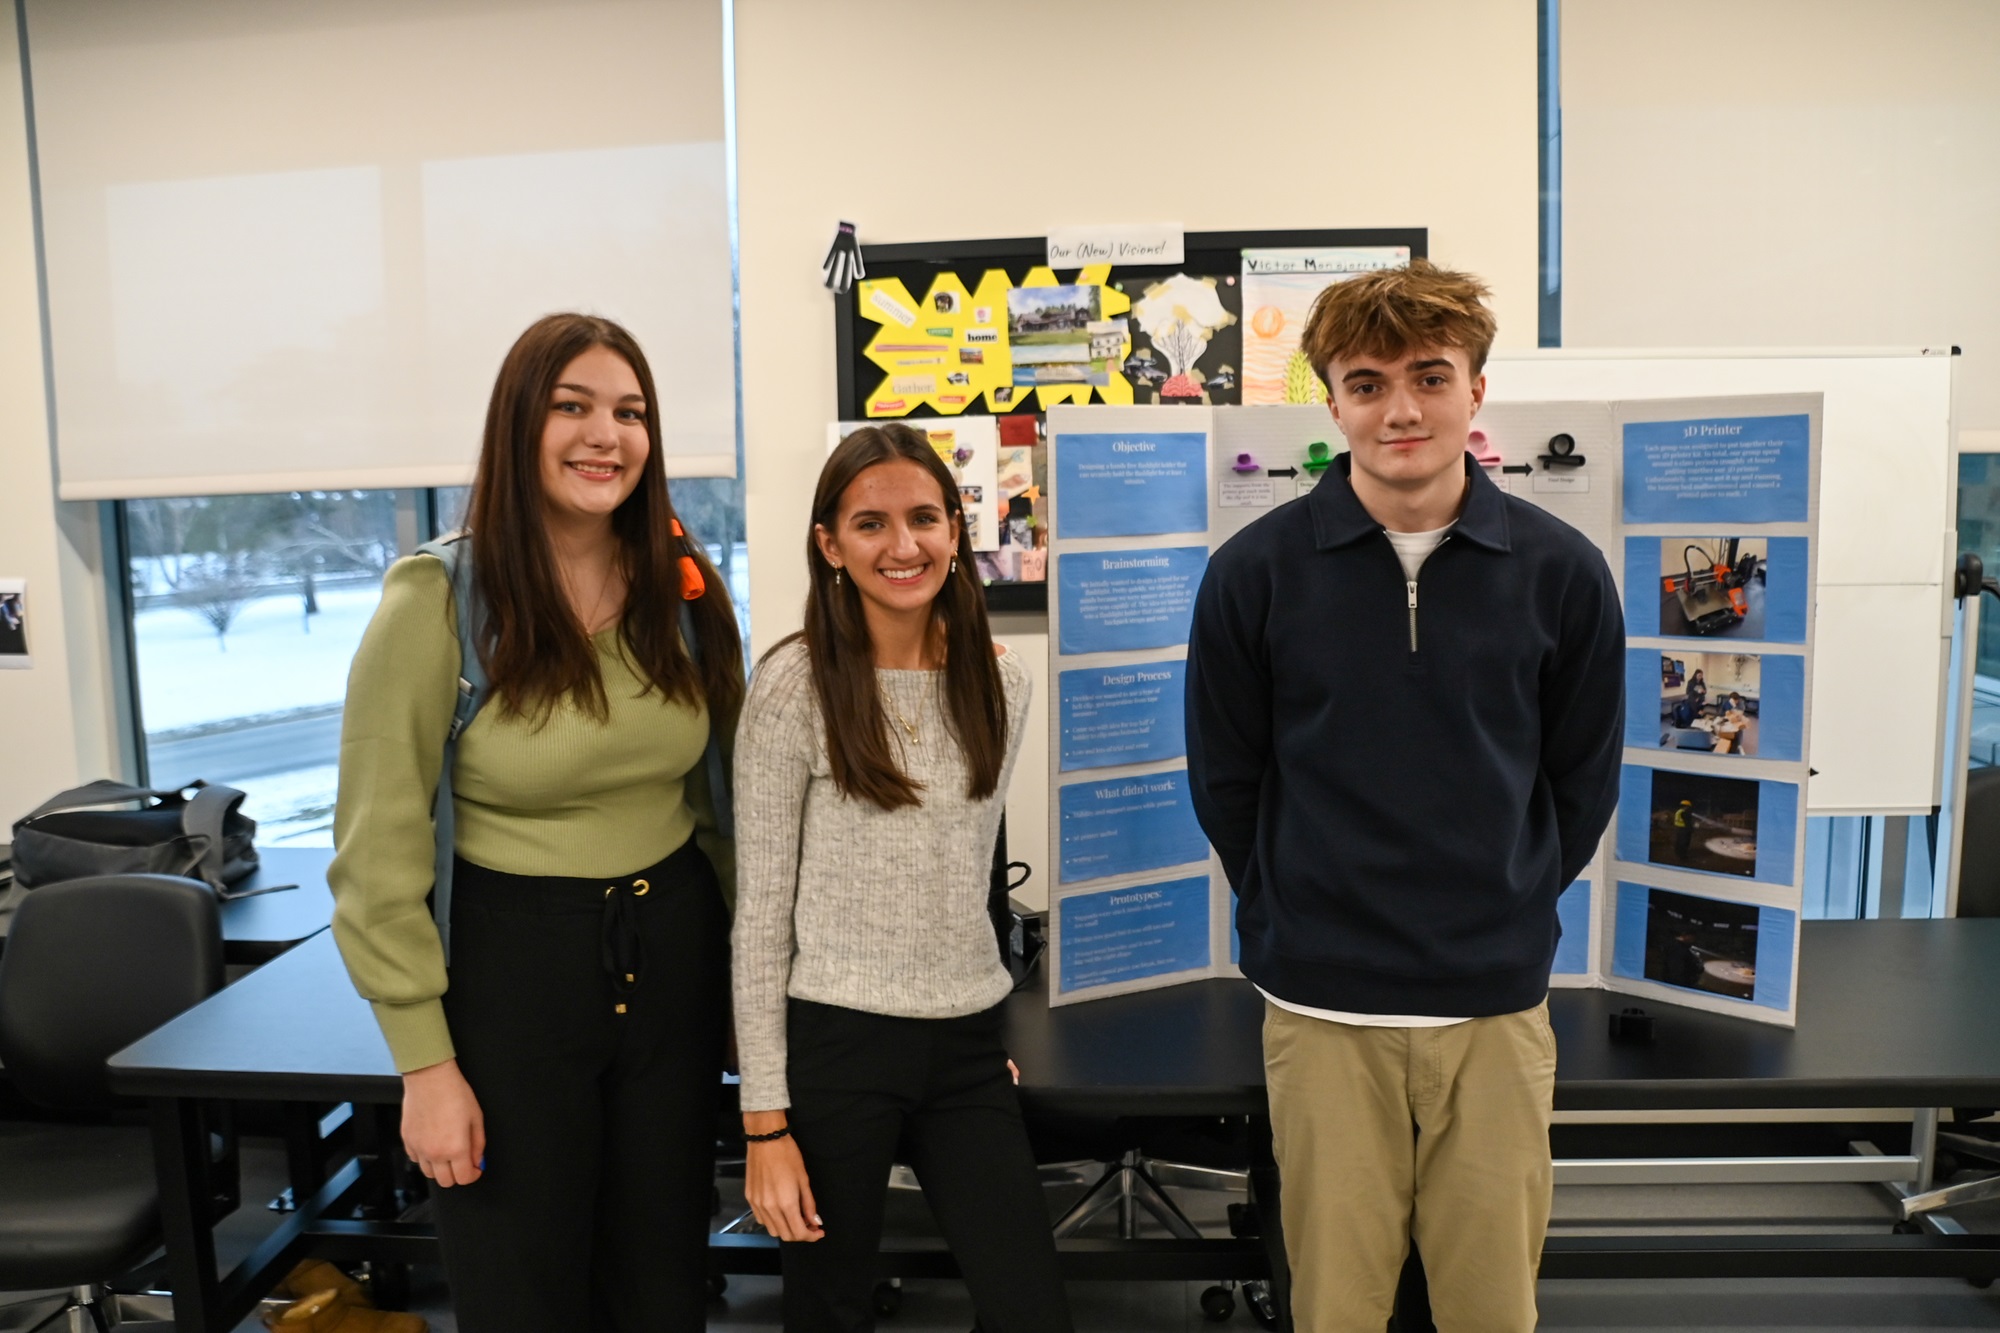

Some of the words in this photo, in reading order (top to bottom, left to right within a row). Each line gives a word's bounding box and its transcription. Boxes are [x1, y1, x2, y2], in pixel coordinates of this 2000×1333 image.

[1050, 245, 1071, 259] Our
[1076, 241, 1114, 260] (New)
[1120, 240, 1166, 256] Visions!
[1248, 260, 1295, 271] Victor
[872, 294, 912, 325] summer
[967, 334, 998, 342] home
[1684, 426, 1697, 438] 3D
[1701, 424, 1743, 436] Printer
[1112, 440, 1156, 454] Objective
[1103, 556, 1169, 570] Brainstorming
[1103, 674, 1136, 686] Design
[1138, 671, 1172, 682] Process
[1096, 788, 1120, 800] What
[1122, 784, 1149, 798] didn't
[1151, 781, 1176, 792] work:
[1110, 890, 1162, 906] Prototypes:
